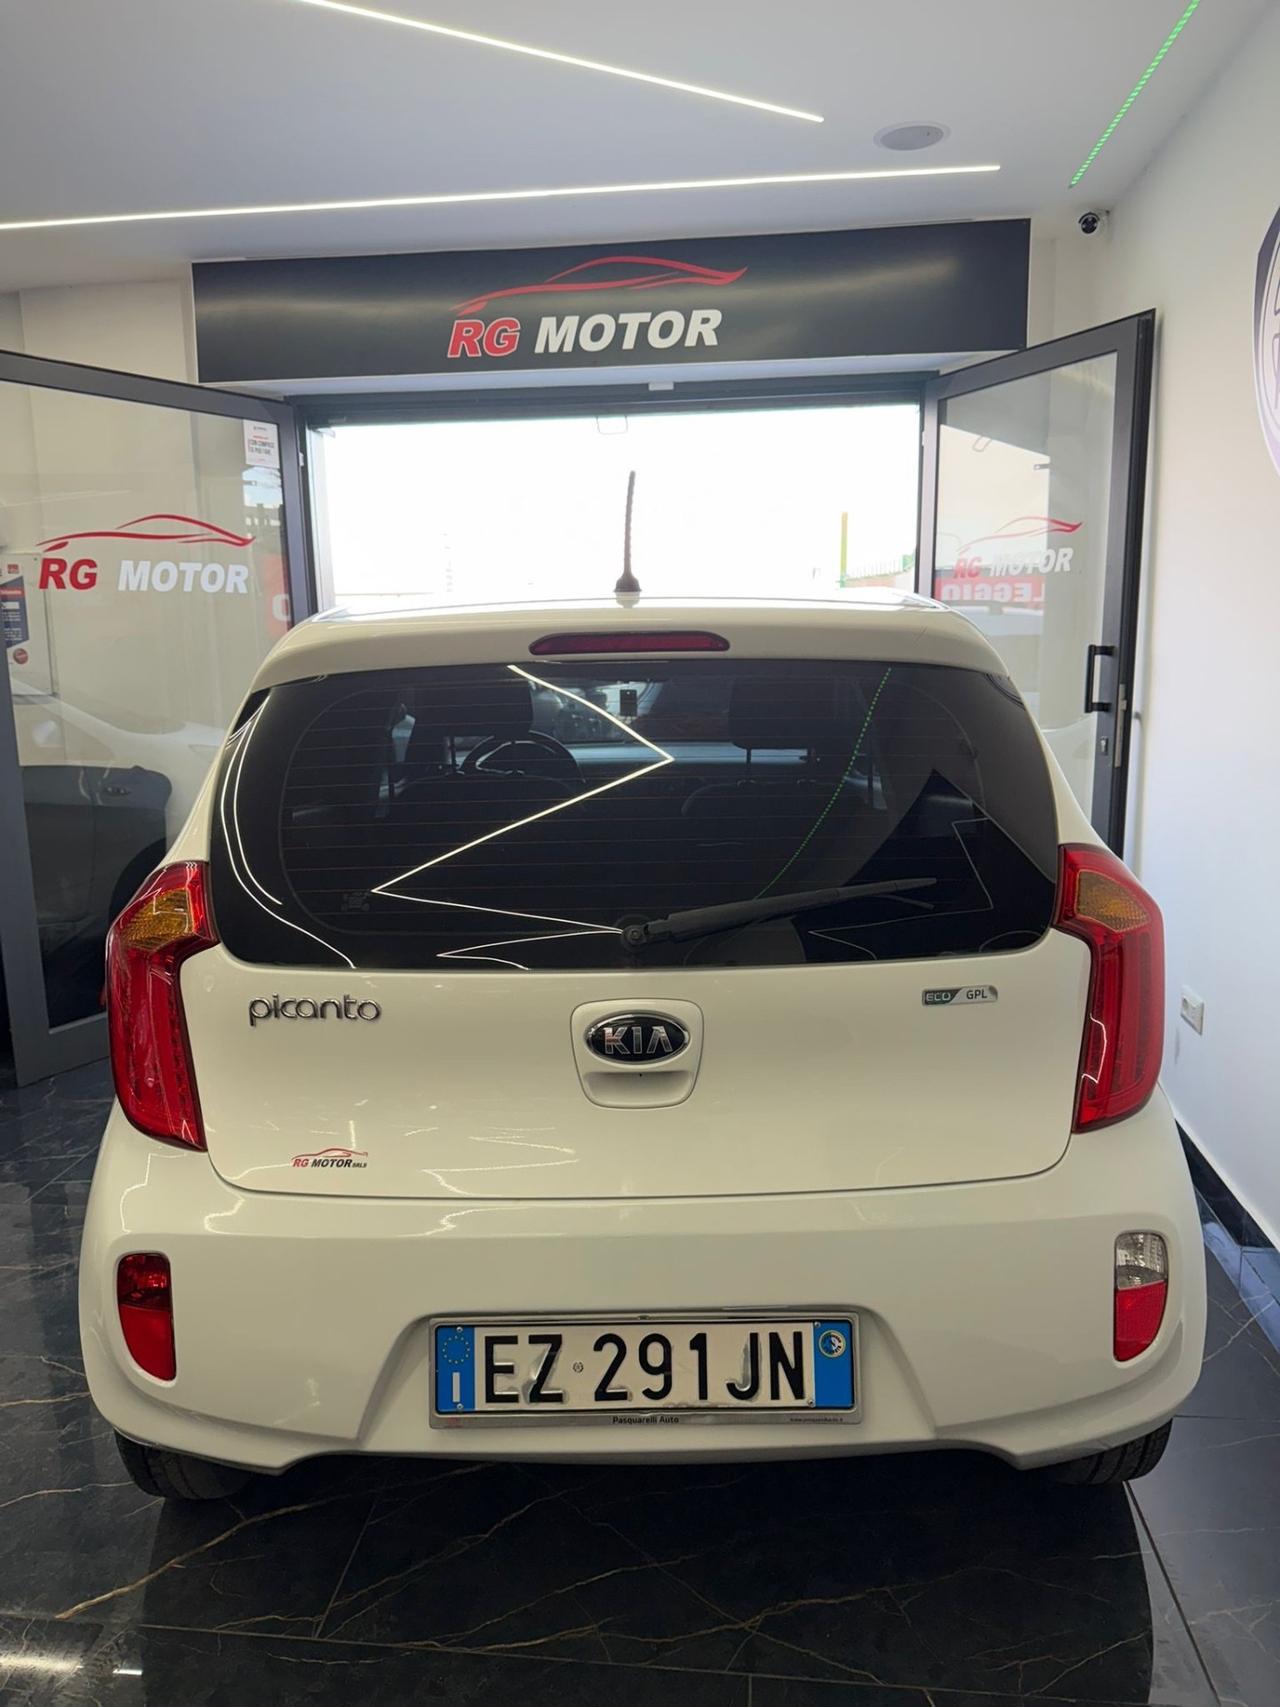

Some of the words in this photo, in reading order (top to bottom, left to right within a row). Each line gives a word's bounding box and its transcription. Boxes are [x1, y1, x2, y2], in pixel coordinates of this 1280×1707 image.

[447, 318, 521, 358] RG
[534, 309, 723, 354] MOTOR
[38, 557, 98, 591] RG
[117, 560, 250, 594] MOTOR
[989, 547, 1074, 577] MOTOR
[249, 993, 381, 1027] picanto
[926, 991, 952, 1002] ECO
[966, 989, 988, 1000] GPL
[603, 1025, 674, 1055] KIA
[293, 1159, 309, 1168] RG
[311, 1159, 353, 1168] MOTOR
[485, 1334, 564, 1404] EZ
[612, 1416, 657, 1425] Pasquarelli
[659, 1416, 680, 1424] Auto
